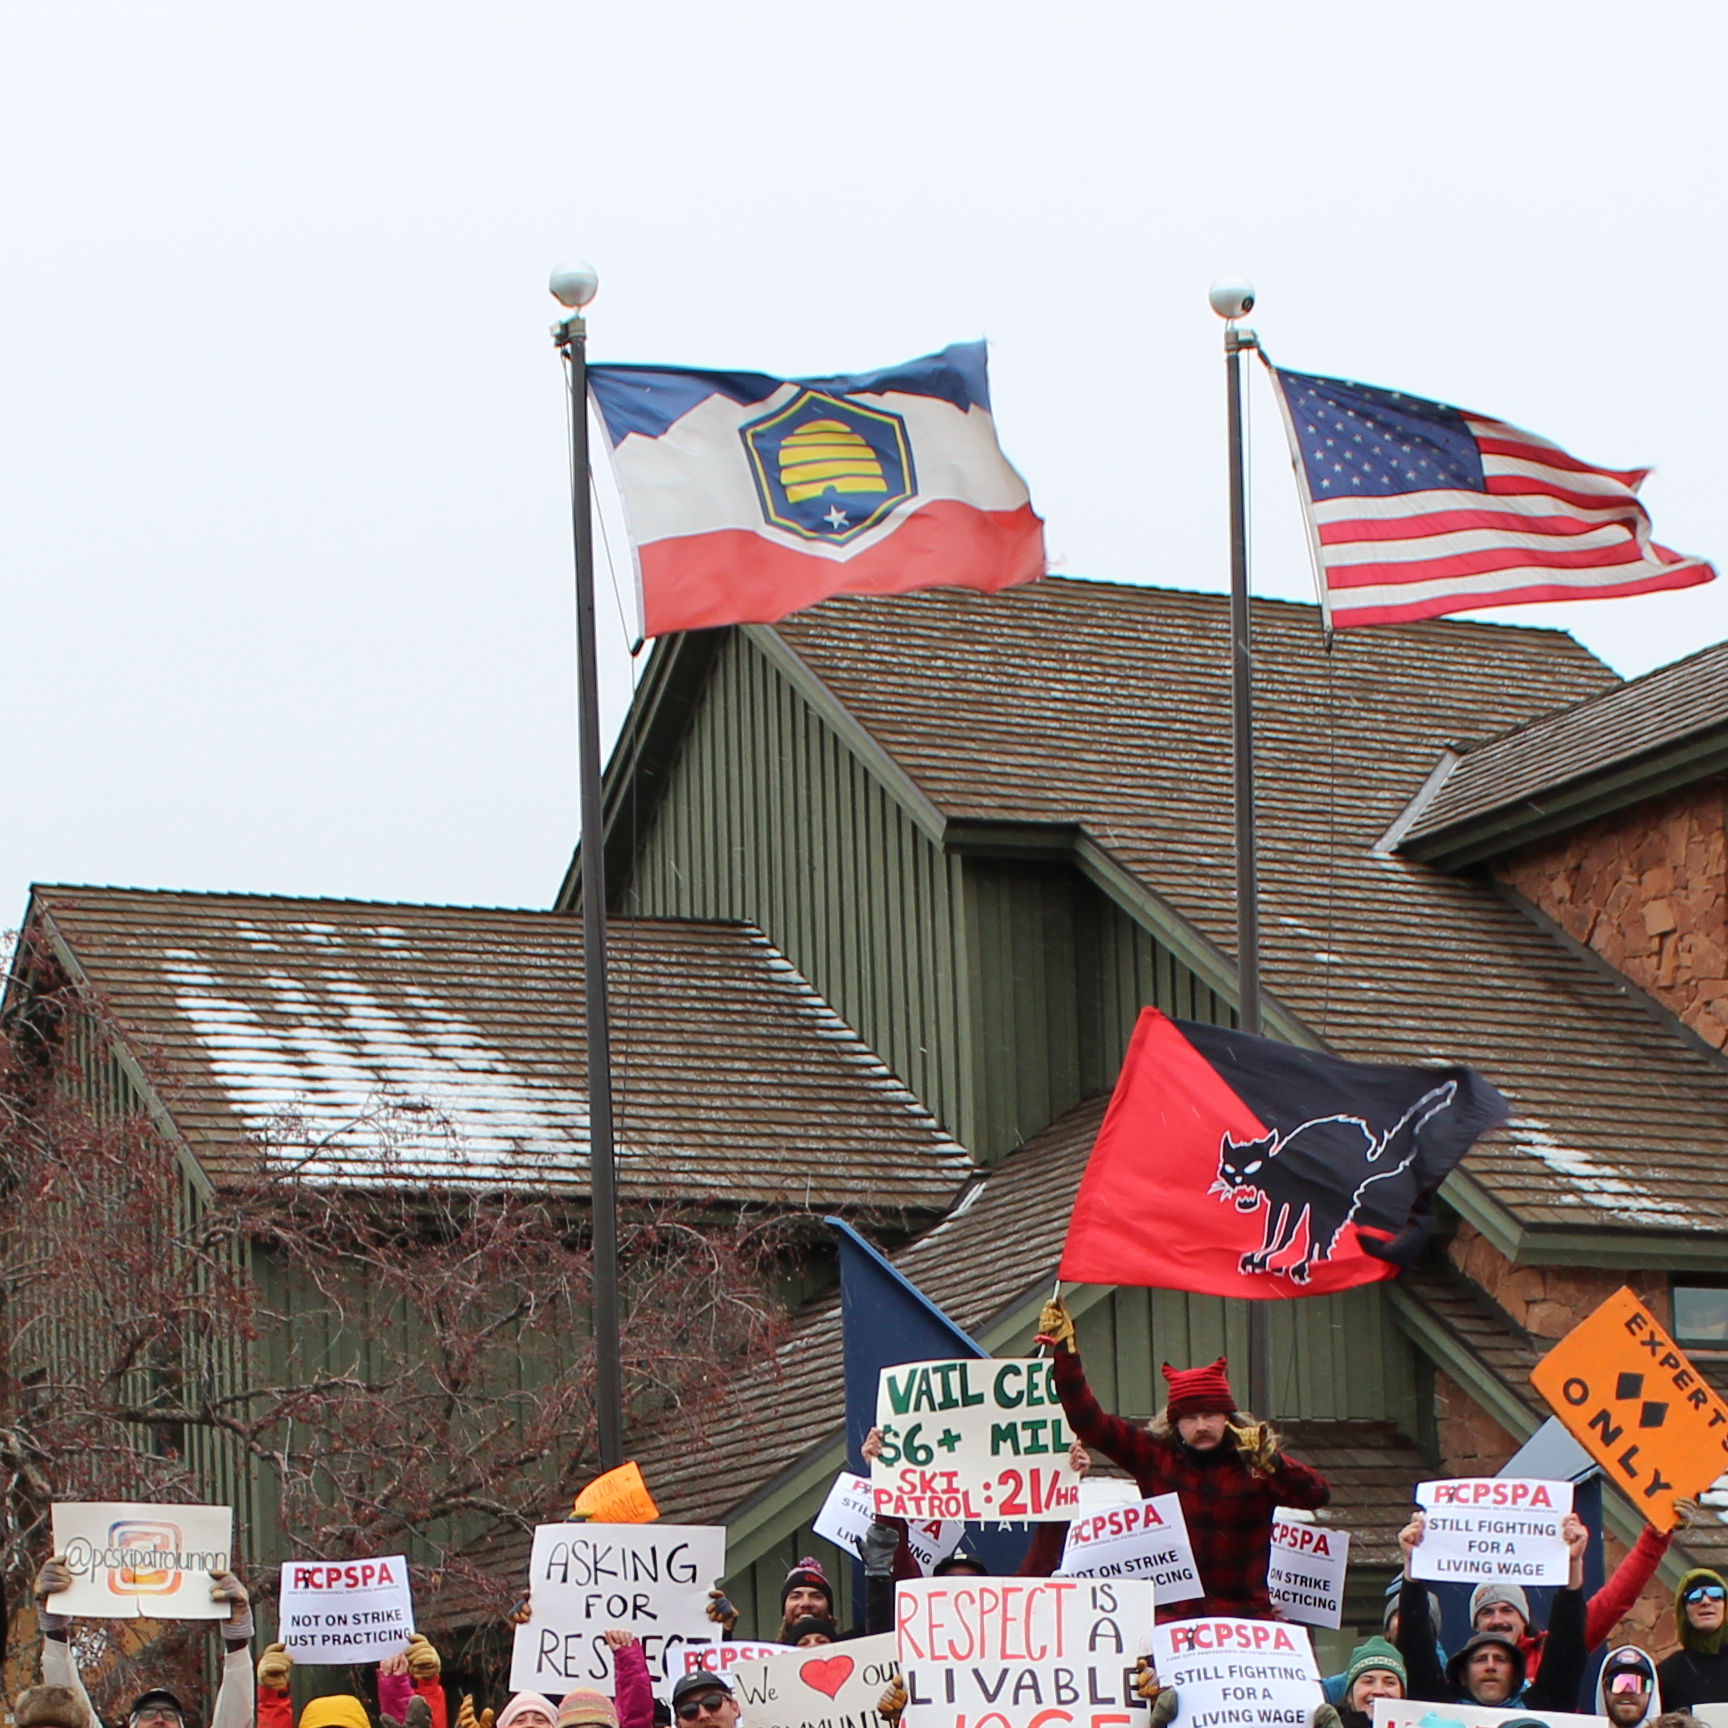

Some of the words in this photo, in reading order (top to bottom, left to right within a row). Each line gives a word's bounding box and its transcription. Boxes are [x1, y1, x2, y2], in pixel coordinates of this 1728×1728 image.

[886, 1362, 984, 1416] VAIL
[991, 1419, 1073, 1456] MIL
[1563, 1377, 1672, 1498] ONLY
[897, 1468, 960, 1495] SKI
[872, 1488, 982, 1519] PATROL
[1433, 1483, 1553, 1508] PCPSPA
[1271, 1522, 1330, 1556] CPSPA
[1429, 1518, 1474, 1532] STILL
[1478, 1520, 1556, 1536] FIGHTING
[65, 1536, 228, 1584] @pcskipatrolunion
[1124, 1550, 1178, 1572] STRIKE
[1468, 1540, 1501, 1554] FOR
[1505, 1542, 1515, 1555] A
[292, 1562, 395, 1590] PCPSPA
[546, 1540, 697, 1586] ASKING
[1437, 1559, 1492, 1574] LIVING
[1498, 1561, 1544, 1576] WAGE
[1286, 1572, 1331, 1591] STRIKE
[291, 1614, 321, 1628] NOT
[325, 1612, 349, 1626] ON
[352, 1608, 403, 1624] STRIKE
[585, 1594, 657, 1620] FOR
[897, 1583, 1077, 1663] RESPECT
[1091, 1583, 1118, 1613] IS
[1089, 1617, 1123, 1654] A
[285, 1633, 317, 1648] JUST
[322, 1629, 412, 1647] PRACTICING
[1170, 1623, 1295, 1654] PCPSPA
[736, 1666, 779, 1704] We
[908, 1666, 1148, 1709] LIVABLE
[1174, 1666, 1223, 1686] STILL
[1228, 1665, 1306, 1681] FIGHTING
[1222, 1687, 1257, 1701] FOR
[1262, 1688, 1273, 1700] A
[1192, 1710, 1253, 1728] LIVING
[1257, 1710, 1305, 1724] WAGE
